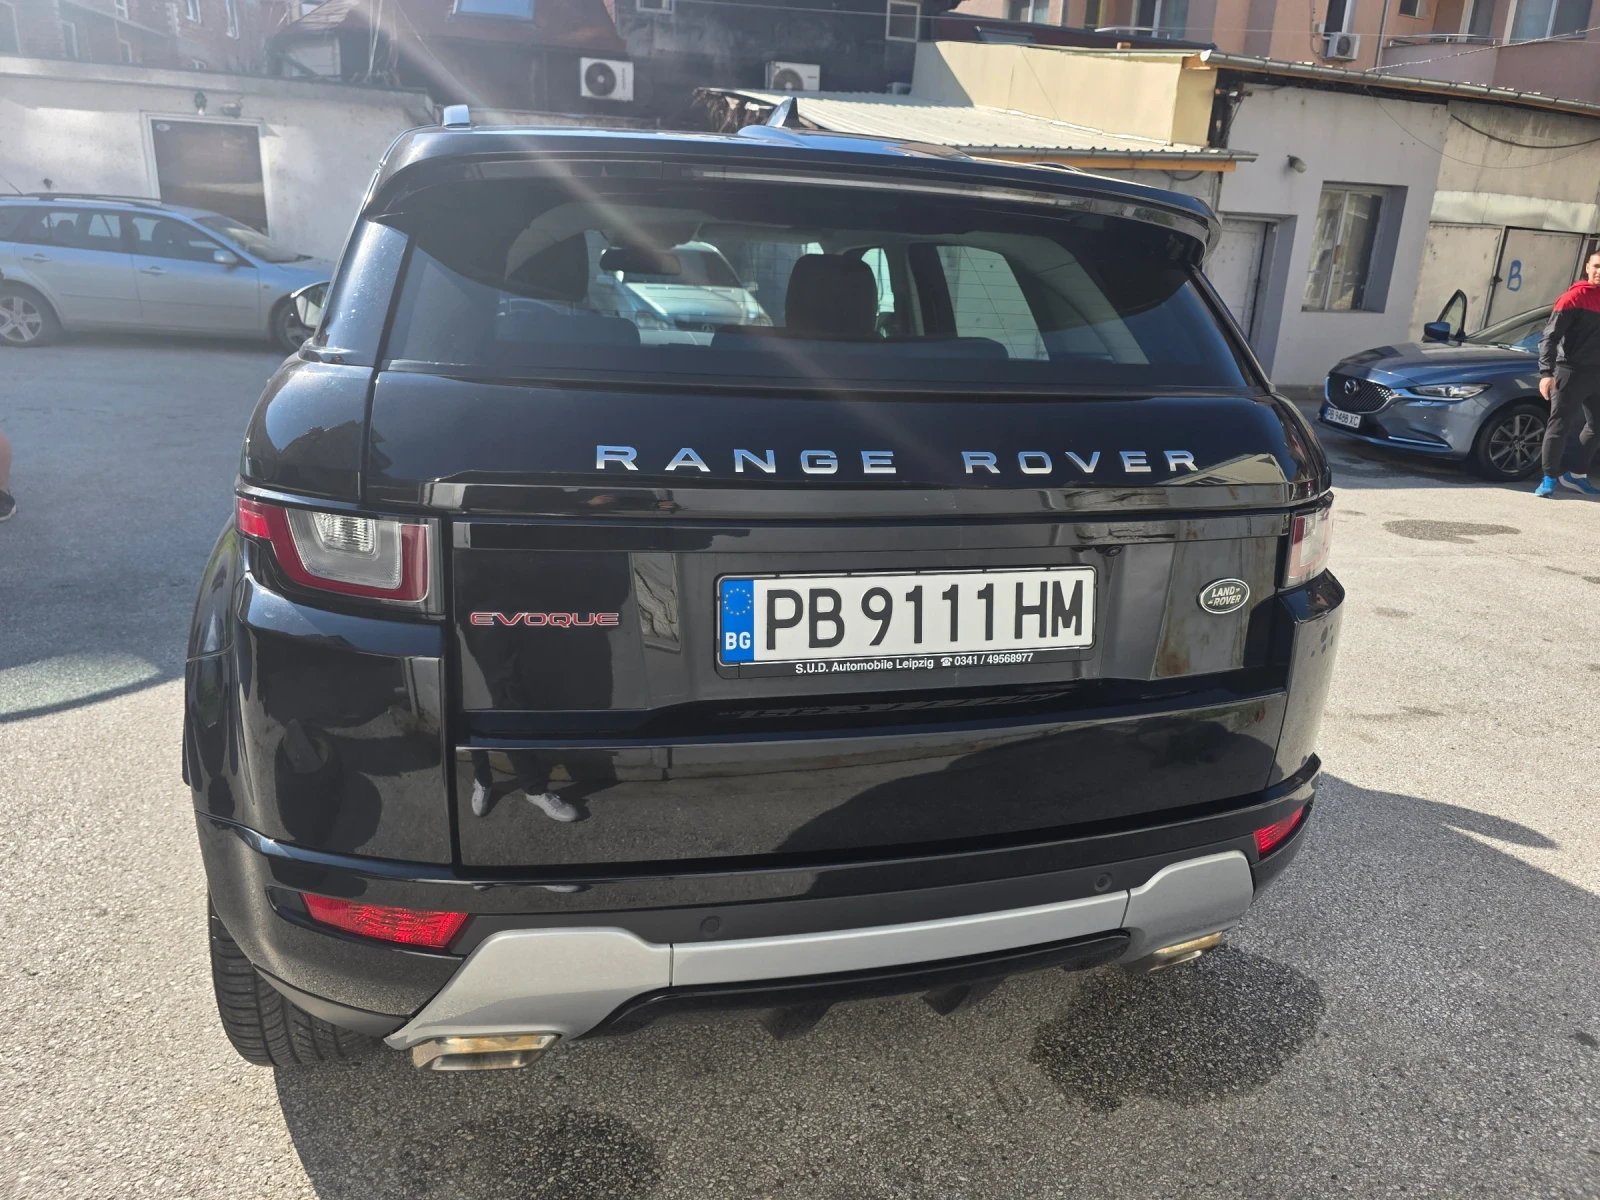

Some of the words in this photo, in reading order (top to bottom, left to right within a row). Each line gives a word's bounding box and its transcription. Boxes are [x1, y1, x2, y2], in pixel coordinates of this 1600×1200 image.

[1507, 260, 1522, 292] B
[596, 445, 897, 474] RANGE
[961, 450, 1199, 475] ROVER
[470, 612, 619, 628] EVOQUE
[766, 588, 845, 651] PB
[861, 583, 994, 646] 9111
[1015, 580, 1083, 640] HM
[725, 631, 751, 650] BG
[795, 662, 829, 674] S.U.D.
[831, 660, 893, 672] Automobile
[896, 658, 934, 670] Leipzig
[954, 655, 978, 666] 0341
[986, 653, 1034, 664] 49568977
